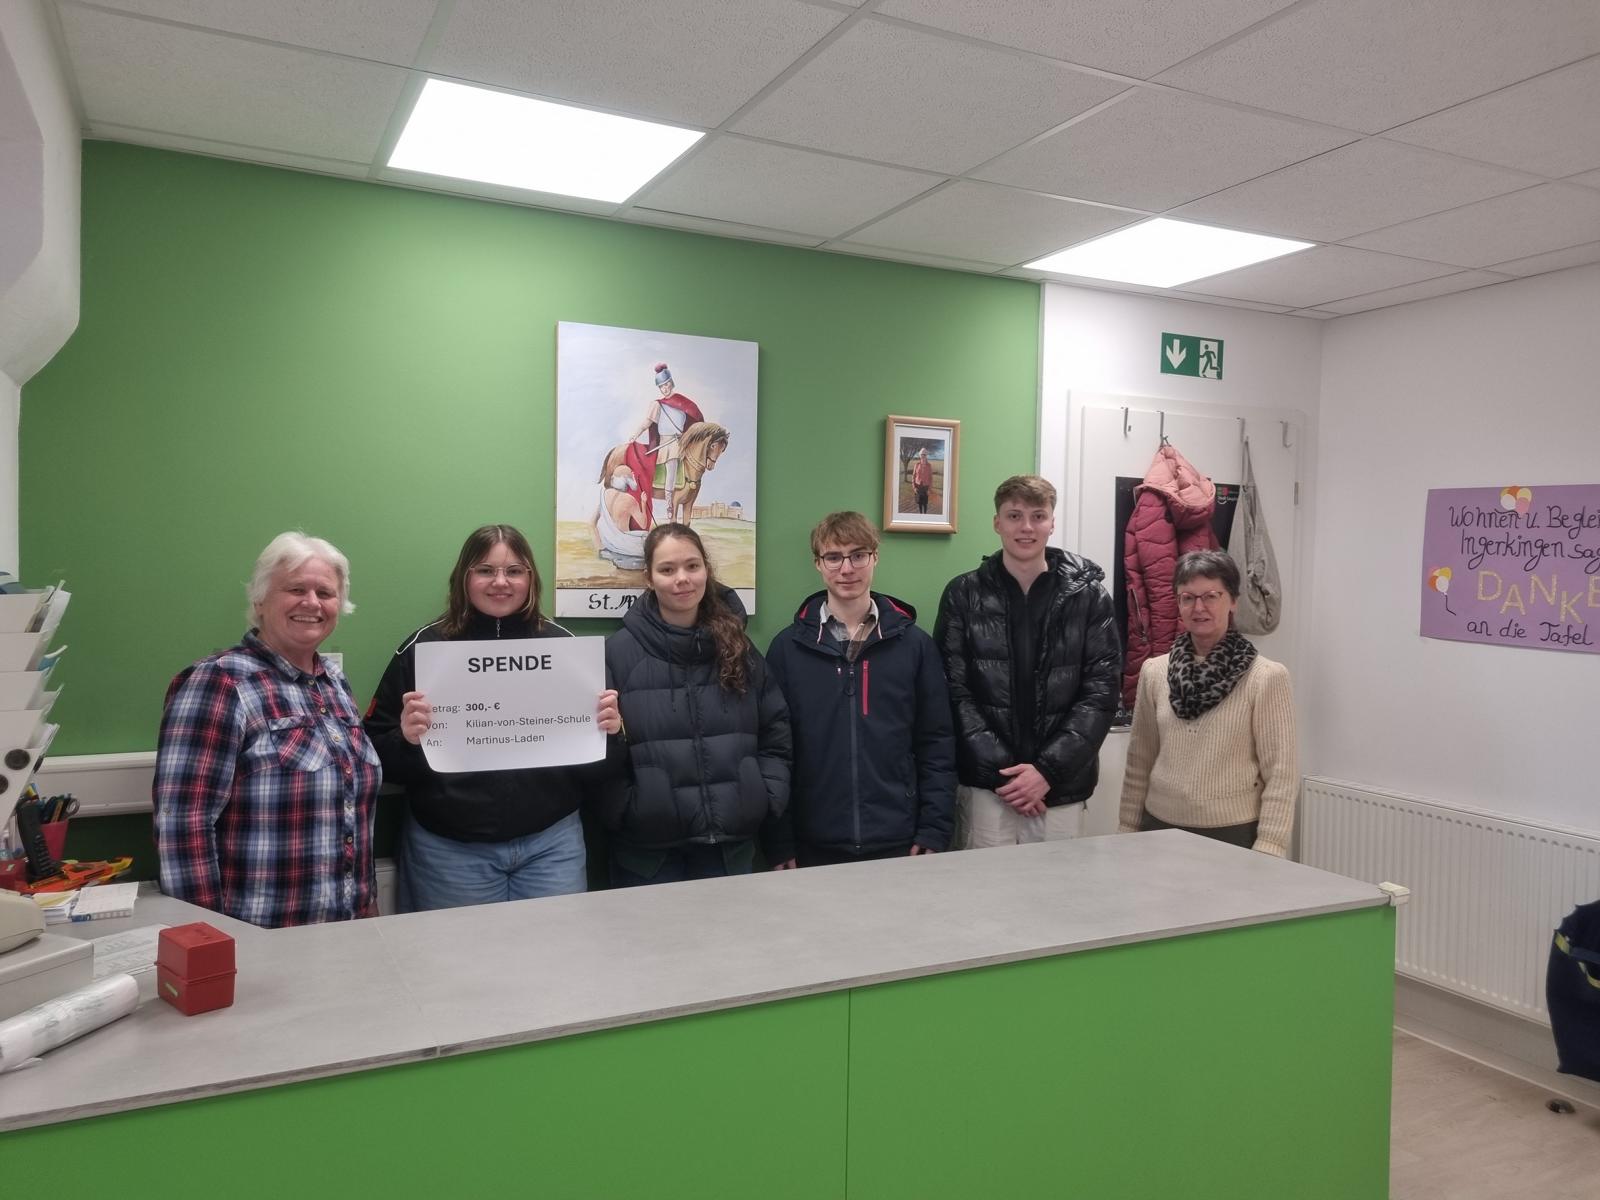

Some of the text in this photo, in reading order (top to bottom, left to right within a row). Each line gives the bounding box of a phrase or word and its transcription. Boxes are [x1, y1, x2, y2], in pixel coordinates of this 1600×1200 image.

[1449, 505, 1519, 529] Wohnen
[1525, 512, 1540, 529] u.
[1460, 529, 1564, 572] Ingerkingen
[588, 593, 614, 610] St.
[1476, 570, 1600, 625] DANKE
[1466, 619, 1594, 647] an die Tafel
[467, 654, 552, 673] SPENDE
[432, 702, 501, 714] etrag: 300,- €
[466, 714, 591, 729] Kilian-von-Steiner-Schule
[426, 733, 545, 747] An: Martinus-Laden
